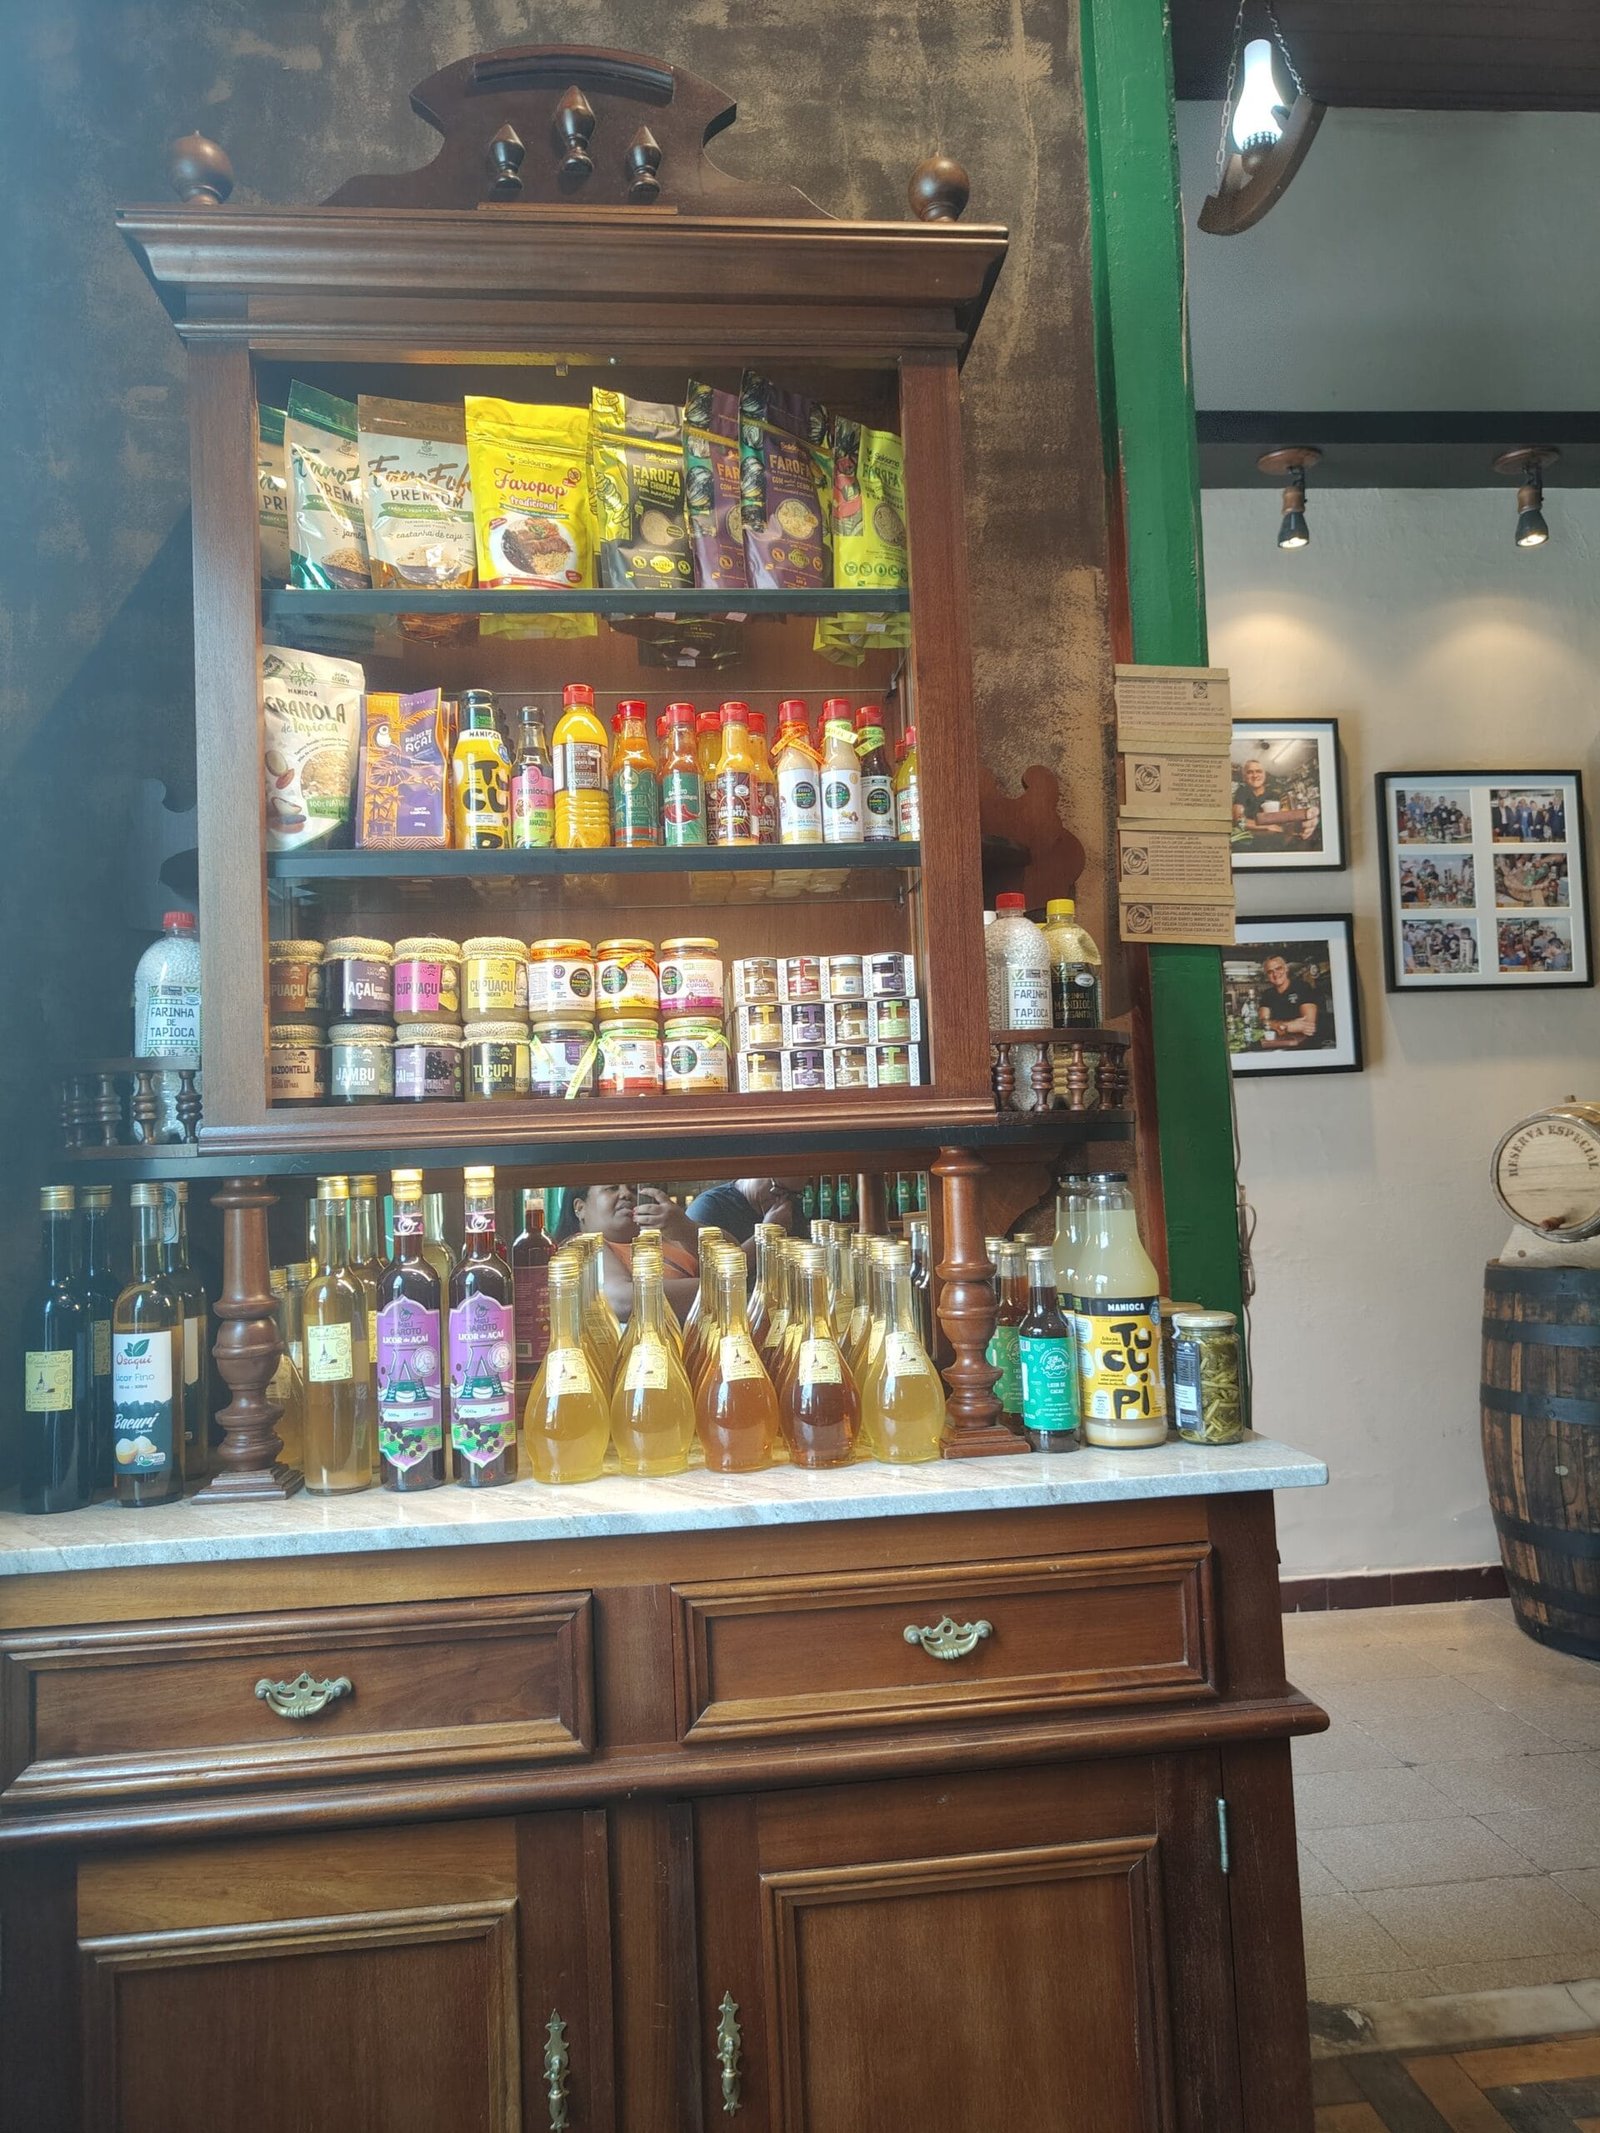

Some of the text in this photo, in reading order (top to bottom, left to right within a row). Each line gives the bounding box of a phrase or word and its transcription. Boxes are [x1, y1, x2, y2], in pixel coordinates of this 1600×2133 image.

[632, 464, 681, 487] FAROFA
[494, 467, 568, 499] Faropop
[390, 489, 463, 509] PREMUM
[510, 496, 558, 512] tradicional
[396, 529, 464, 542] castanha de caju
[287, 688, 318, 697] MANIOCA
[265, 696, 346, 724] GRANOLA
[517, 788, 549, 796] Mnioca
[396, 983, 438, 998] CUPAÇU
[1013, 989, 1048, 1000] FARINHA
[151, 1007, 195, 1018] FARINHA
[1014, 1008, 1049, 1018] TAPIOCA
[151, 1027, 196, 1038] TAPIOCA
[335, 1067, 376, 1082] JAMBU
[472, 1064, 513, 1078] TUCUPI
[1508, 1125, 1599, 1177] RESERVA ESPECIAL
[1107, 1303, 1146, 1312] MANIOCA
[382, 1336, 402, 1344] LICOR
[411, 1334, 429, 1344] AÇAÍ
[458, 1333, 479, 1341] LICOR
[487, 1329, 505, 1339] AÇAÍ
[134, 1373, 155, 1382] Fino
[114, 1413, 160, 1431] Bacuri
